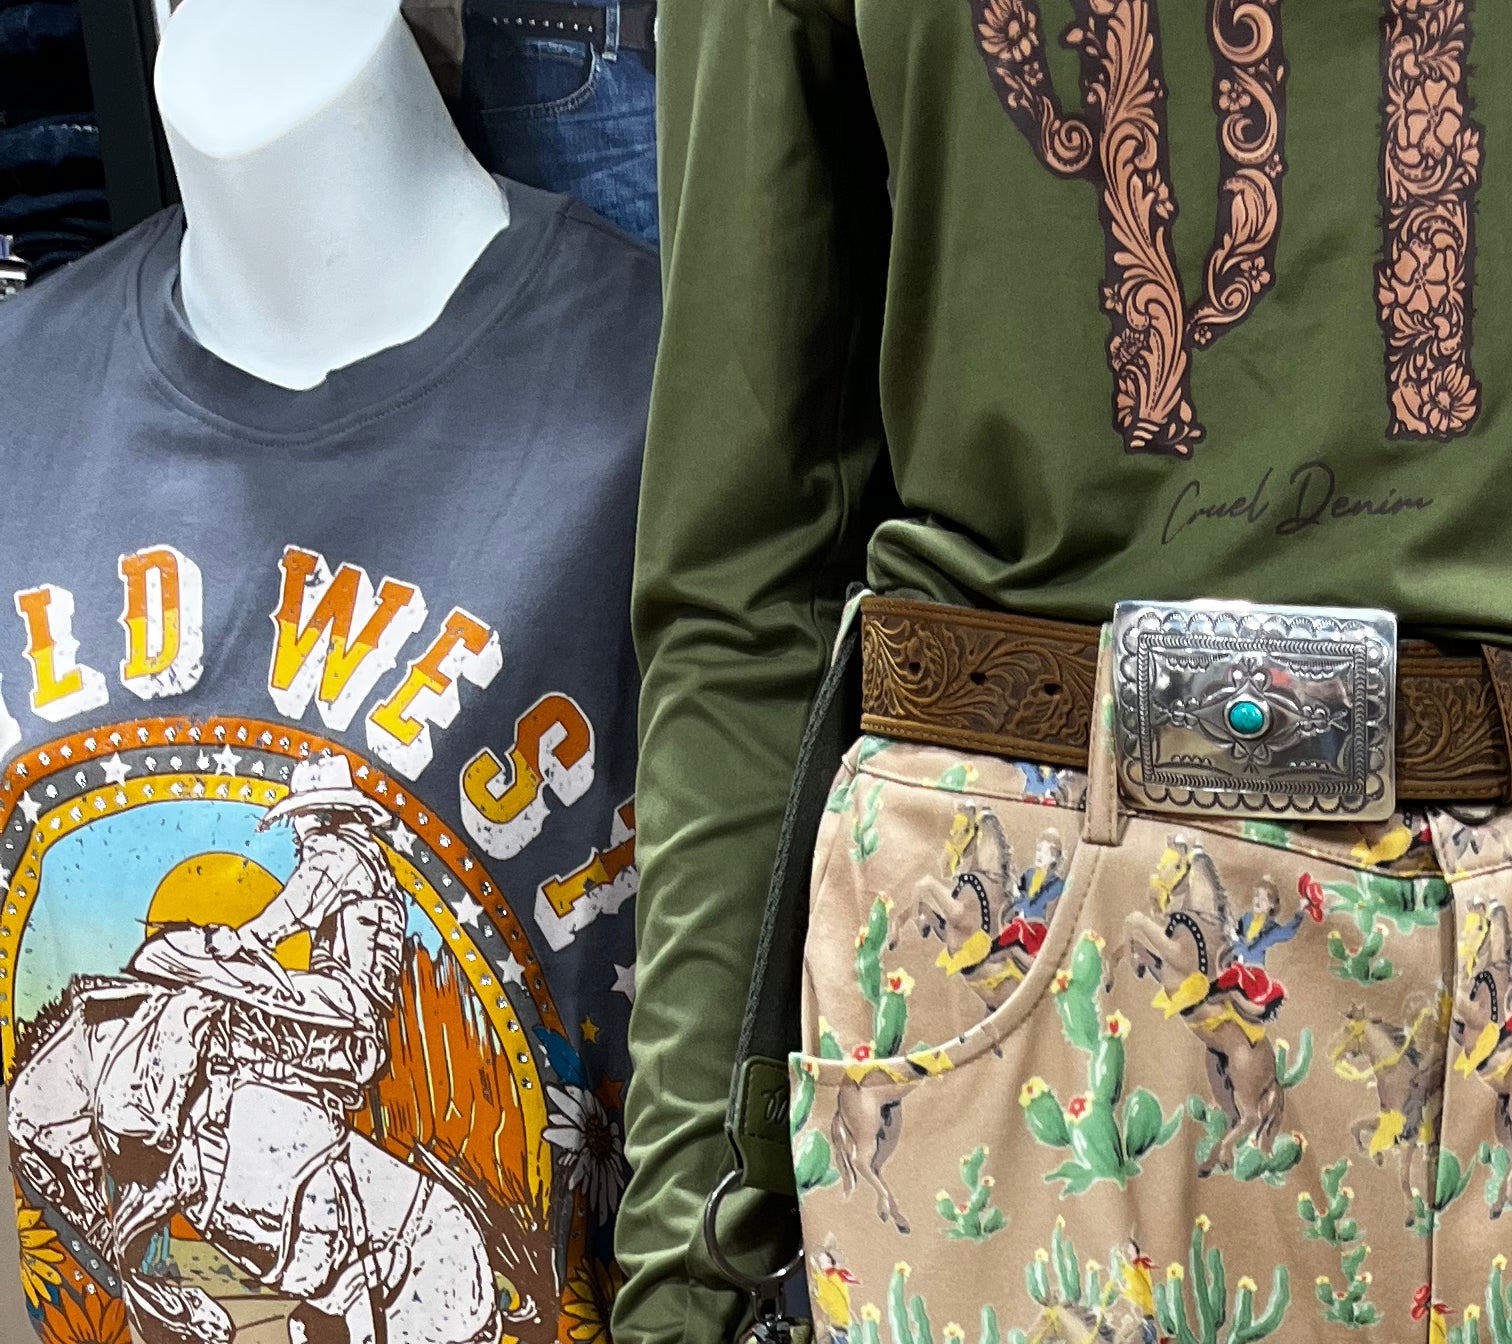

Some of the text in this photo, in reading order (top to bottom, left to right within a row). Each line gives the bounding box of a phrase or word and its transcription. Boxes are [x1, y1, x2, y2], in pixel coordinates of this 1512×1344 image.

[1161, 461, 1434, 544] Cruel Denim
[0, 545, 204, 725] LD
